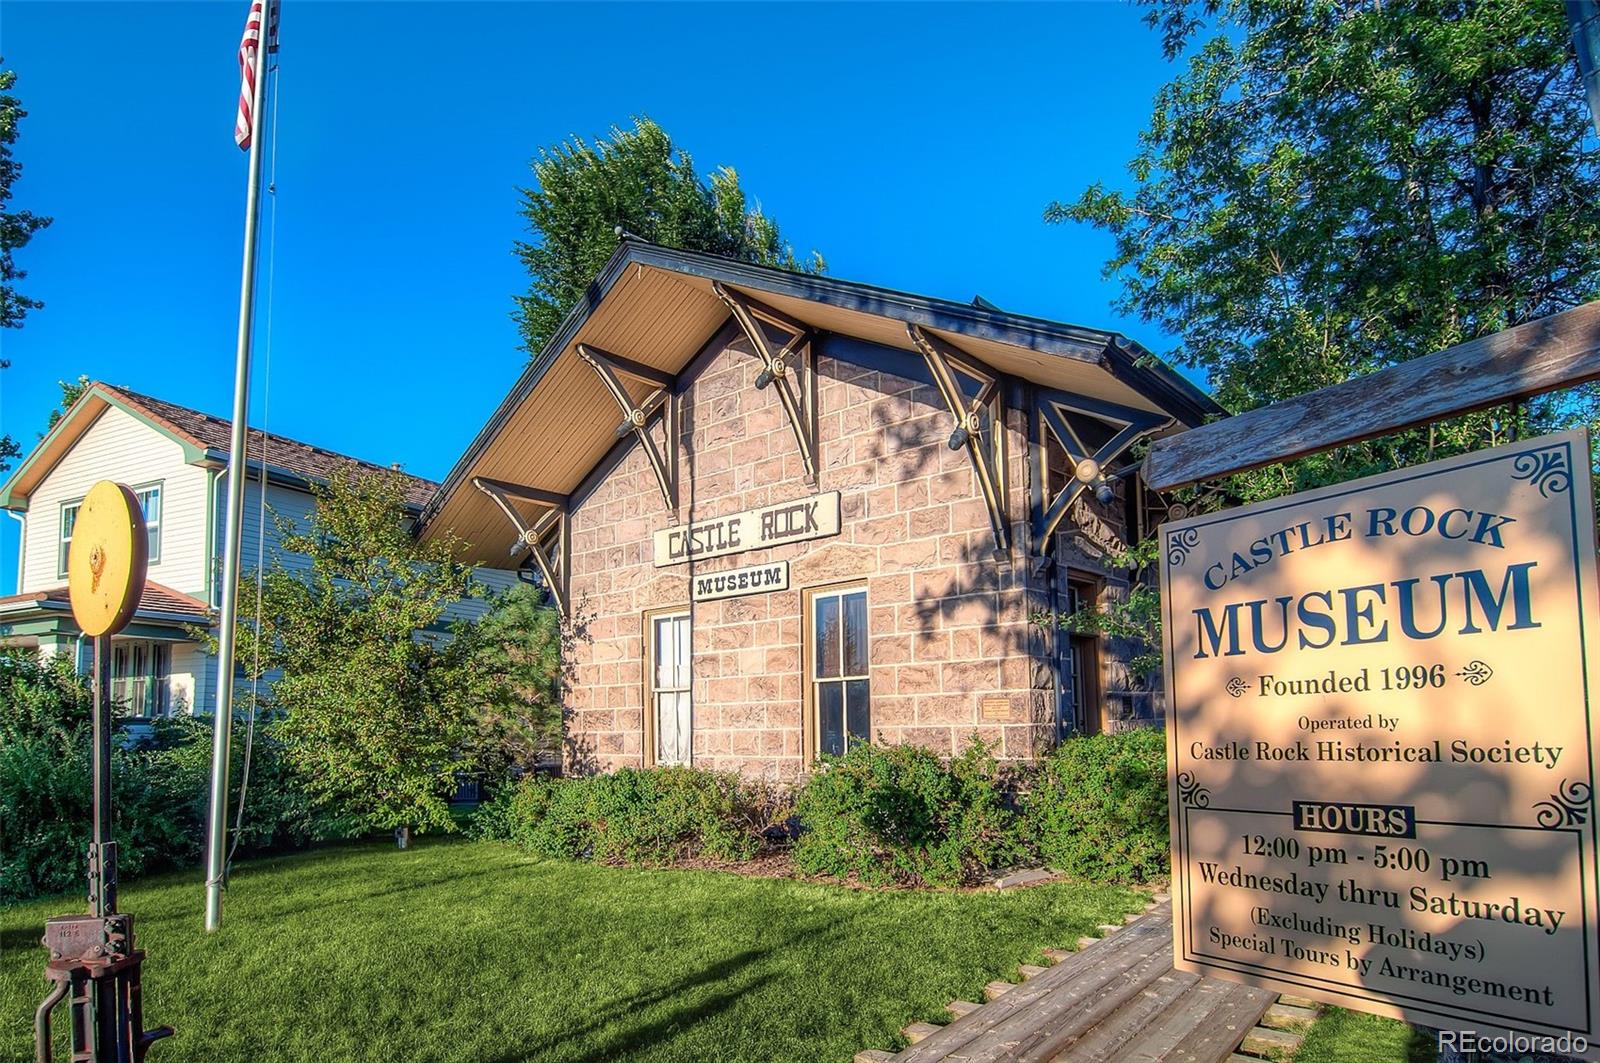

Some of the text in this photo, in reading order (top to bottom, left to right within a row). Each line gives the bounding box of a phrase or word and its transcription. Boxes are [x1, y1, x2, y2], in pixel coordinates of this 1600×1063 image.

[668, 501, 819, 559] CASTLE ROCK
[1203, 506, 1516, 591] CASTLE ROCK
[697, 567, 781, 595] MUSEUM
[1191, 561, 1542, 659] MUSEUM
[1258, 664, 1446, 697] Founded 1996
[1298, 714, 1399, 733] Operated by
[1190, 740, 1563, 769] Castle Rock Historical Society
[1300, 804, 1407, 835] HOURS
[1241, 834, 1299, 860] 12:00
[1307, 848, 1347, 867] pm
[1374, 845, 1430, 873] 5:00
[1440, 857, 1491, 882] pm
[1198, 862, 1565, 935] Wednesday thru Saturday
[1250, 906, 1485, 963] (Excluding Holidays)
[1209, 927, 1554, 1007] Special Tours by Arrangement
